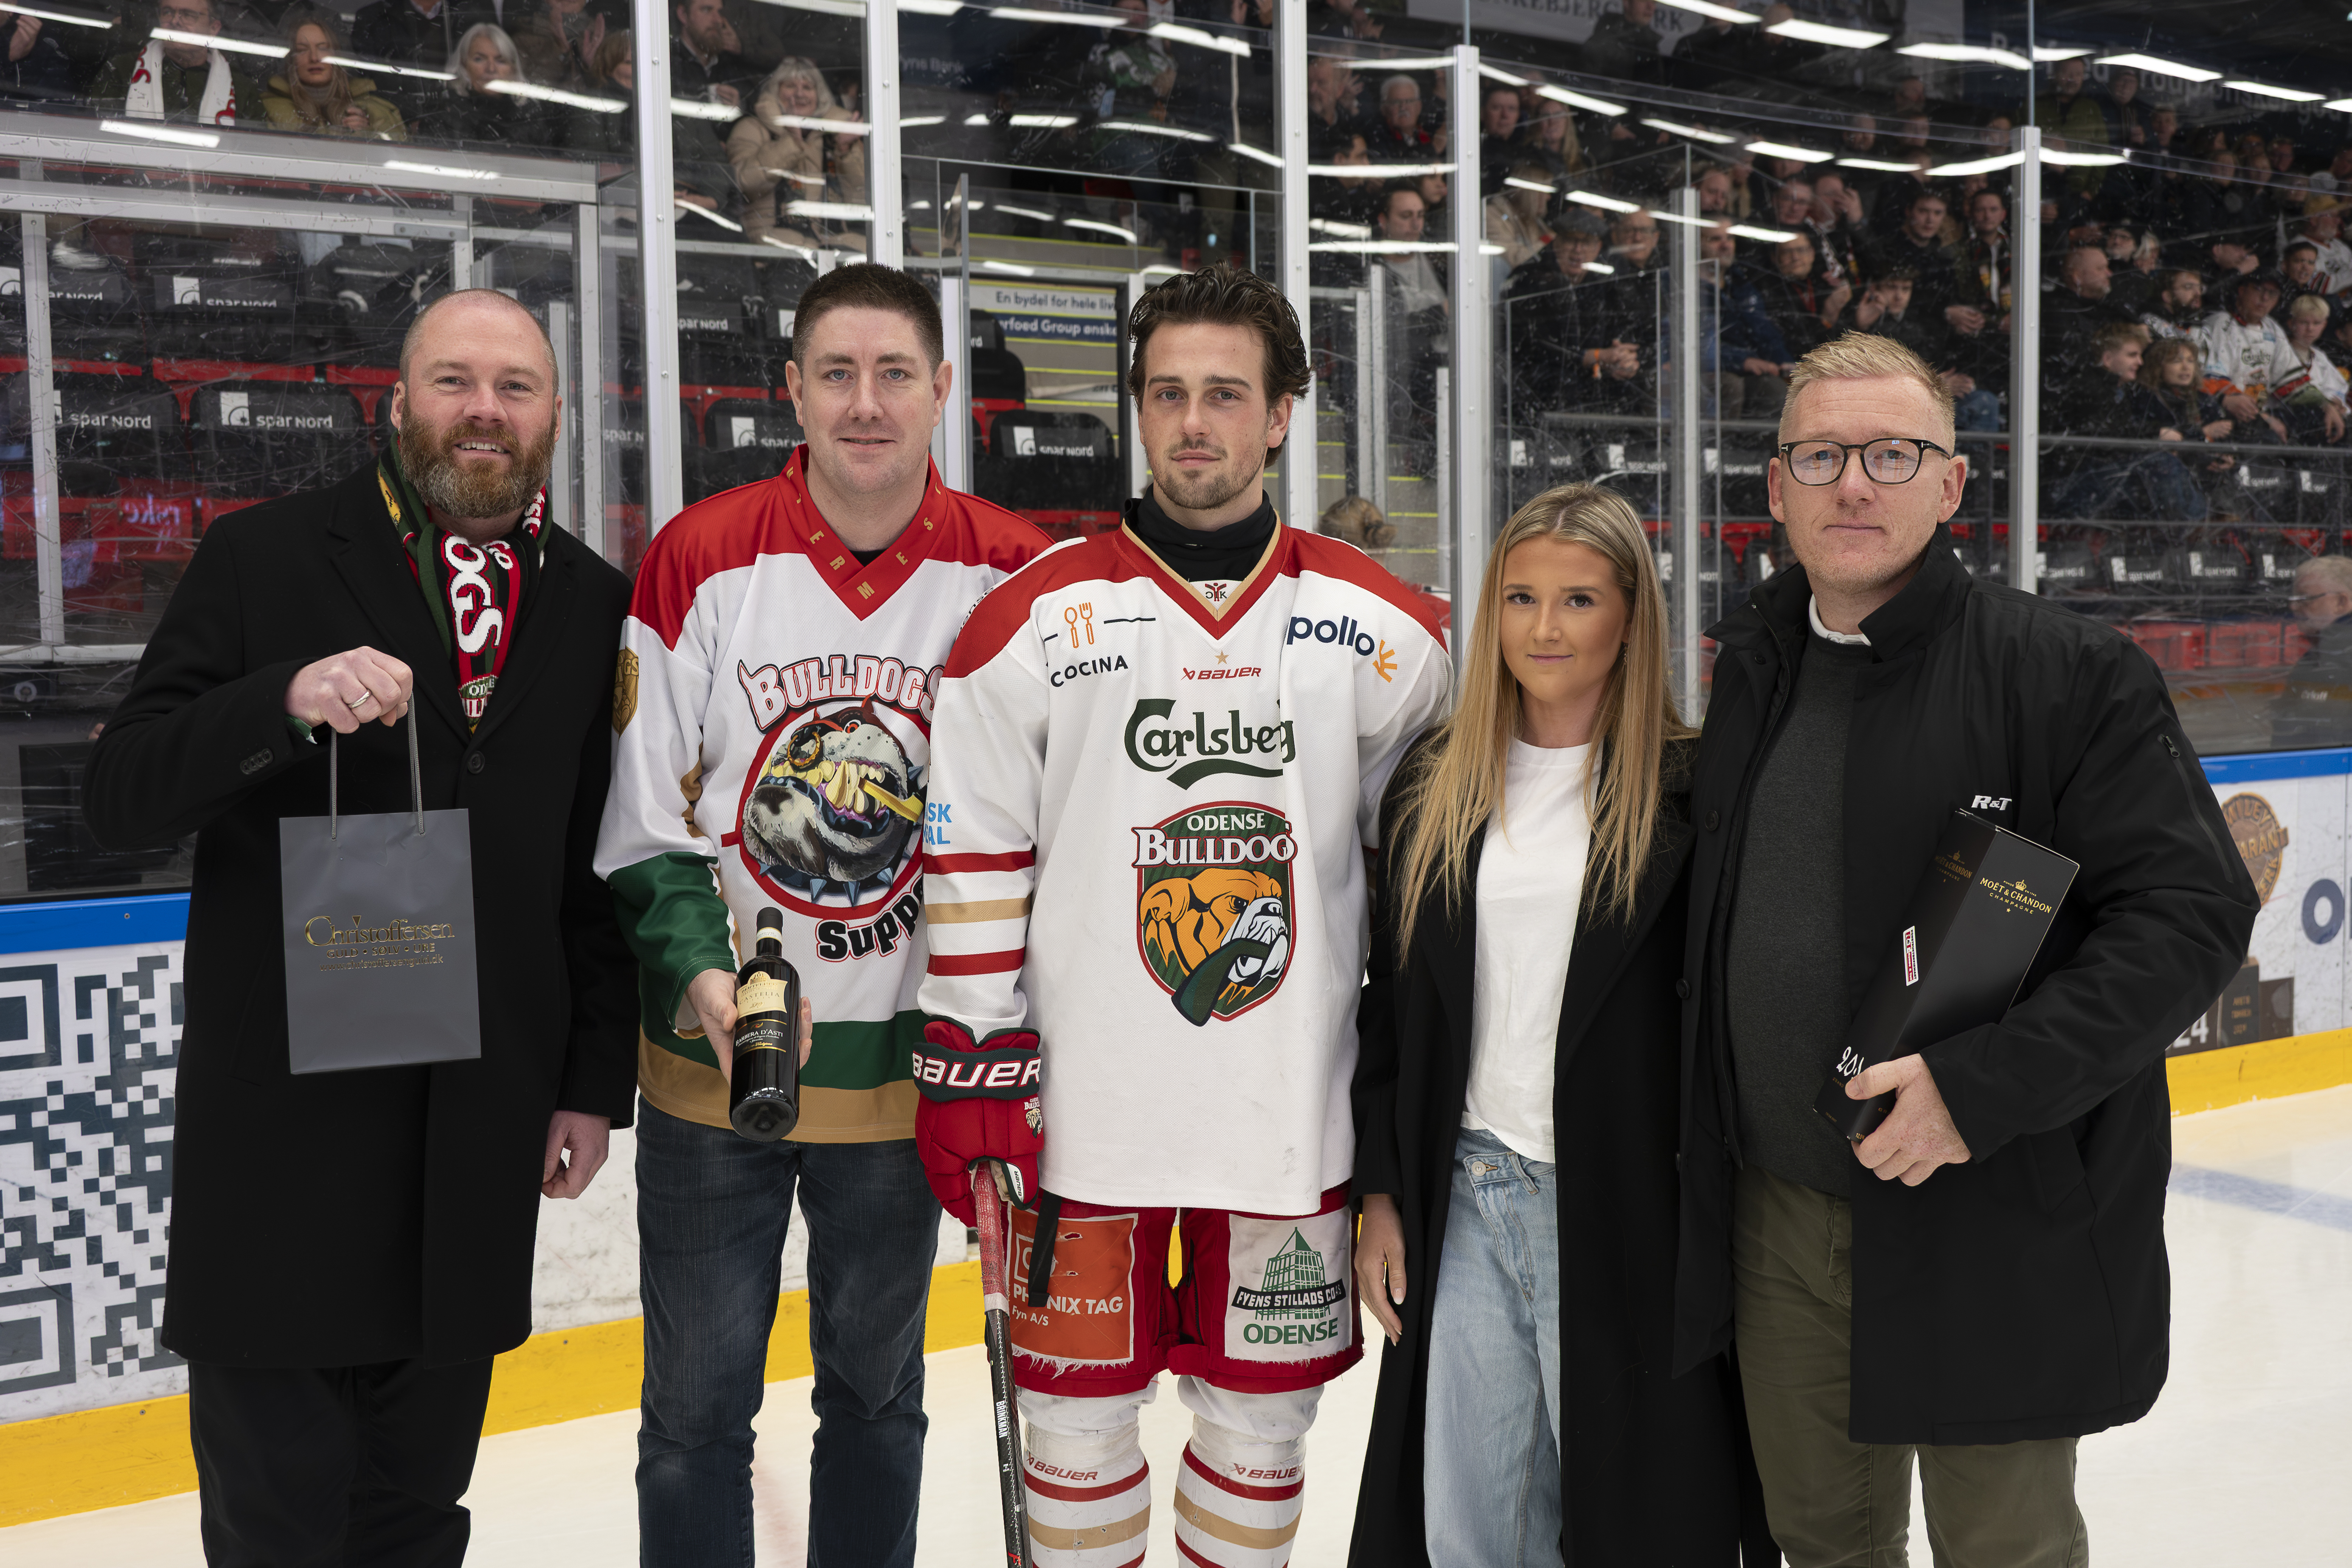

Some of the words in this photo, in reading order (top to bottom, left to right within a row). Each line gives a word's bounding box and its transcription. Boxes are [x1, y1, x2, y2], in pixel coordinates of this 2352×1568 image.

[996, 291, 1011, 303] En
[1014, 292, 1048, 308] bydel
[1051, 295, 1067, 306] for
[1071, 296, 1096, 309] hele
[1040, 319, 1081, 337] Group
[112, 415, 152, 429] Nord
[295, 415, 333, 428] Nord
[1286, 615, 1375, 656] pollo
[1050, 655, 1128, 688] COCINA
[1197, 666, 1261, 680] BAUER
[1124, 698, 1296, 773] Carlsbeg
[1971, 795, 2012, 811] R&T
[1187, 812, 1266, 832] ODENSE
[1136, 829, 1295, 867] BULLDOG
[1947, 862, 1973, 879] CHANDON
[1979, 877, 2005, 893] MOËT
[2004, 888, 2009, 896] &
[2010, 891, 2052, 914] CHANDON
[1989, 892, 2034, 914] CHAMPAGNE
[304, 915, 455, 947] Christoffersen
[326, 947, 359, 959] GULD
[372, 945, 401, 956] SØLV
[413, 942, 436, 953] URE
[319, 954, 444, 972] www.christoffersenguld.dk
[739, 992, 780, 1005] CASTELIA
[736, 1031, 759, 1046] BARBERA
[761, 1028, 783, 1037] D'ASTI
[912, 1052, 1041, 1088] BAUER
[1013, 1170, 1023, 1197] BAUER
[1013, 1283, 1082, 1315] PHNIX
[1085, 1296, 1123, 1315] TAG
[1236, 1291, 1271, 1307] FYENS
[1274, 1290, 1324, 1307] STILLADS
[1012, 1305, 1027, 1321] Fyn
[1030, 1313, 1049, 1326] A/S
[1243, 1317, 1338, 1345] ODENSE
[995, 1401, 1009, 1439] BRINKMAN
[1034, 1461, 1099, 1481] BAUER
